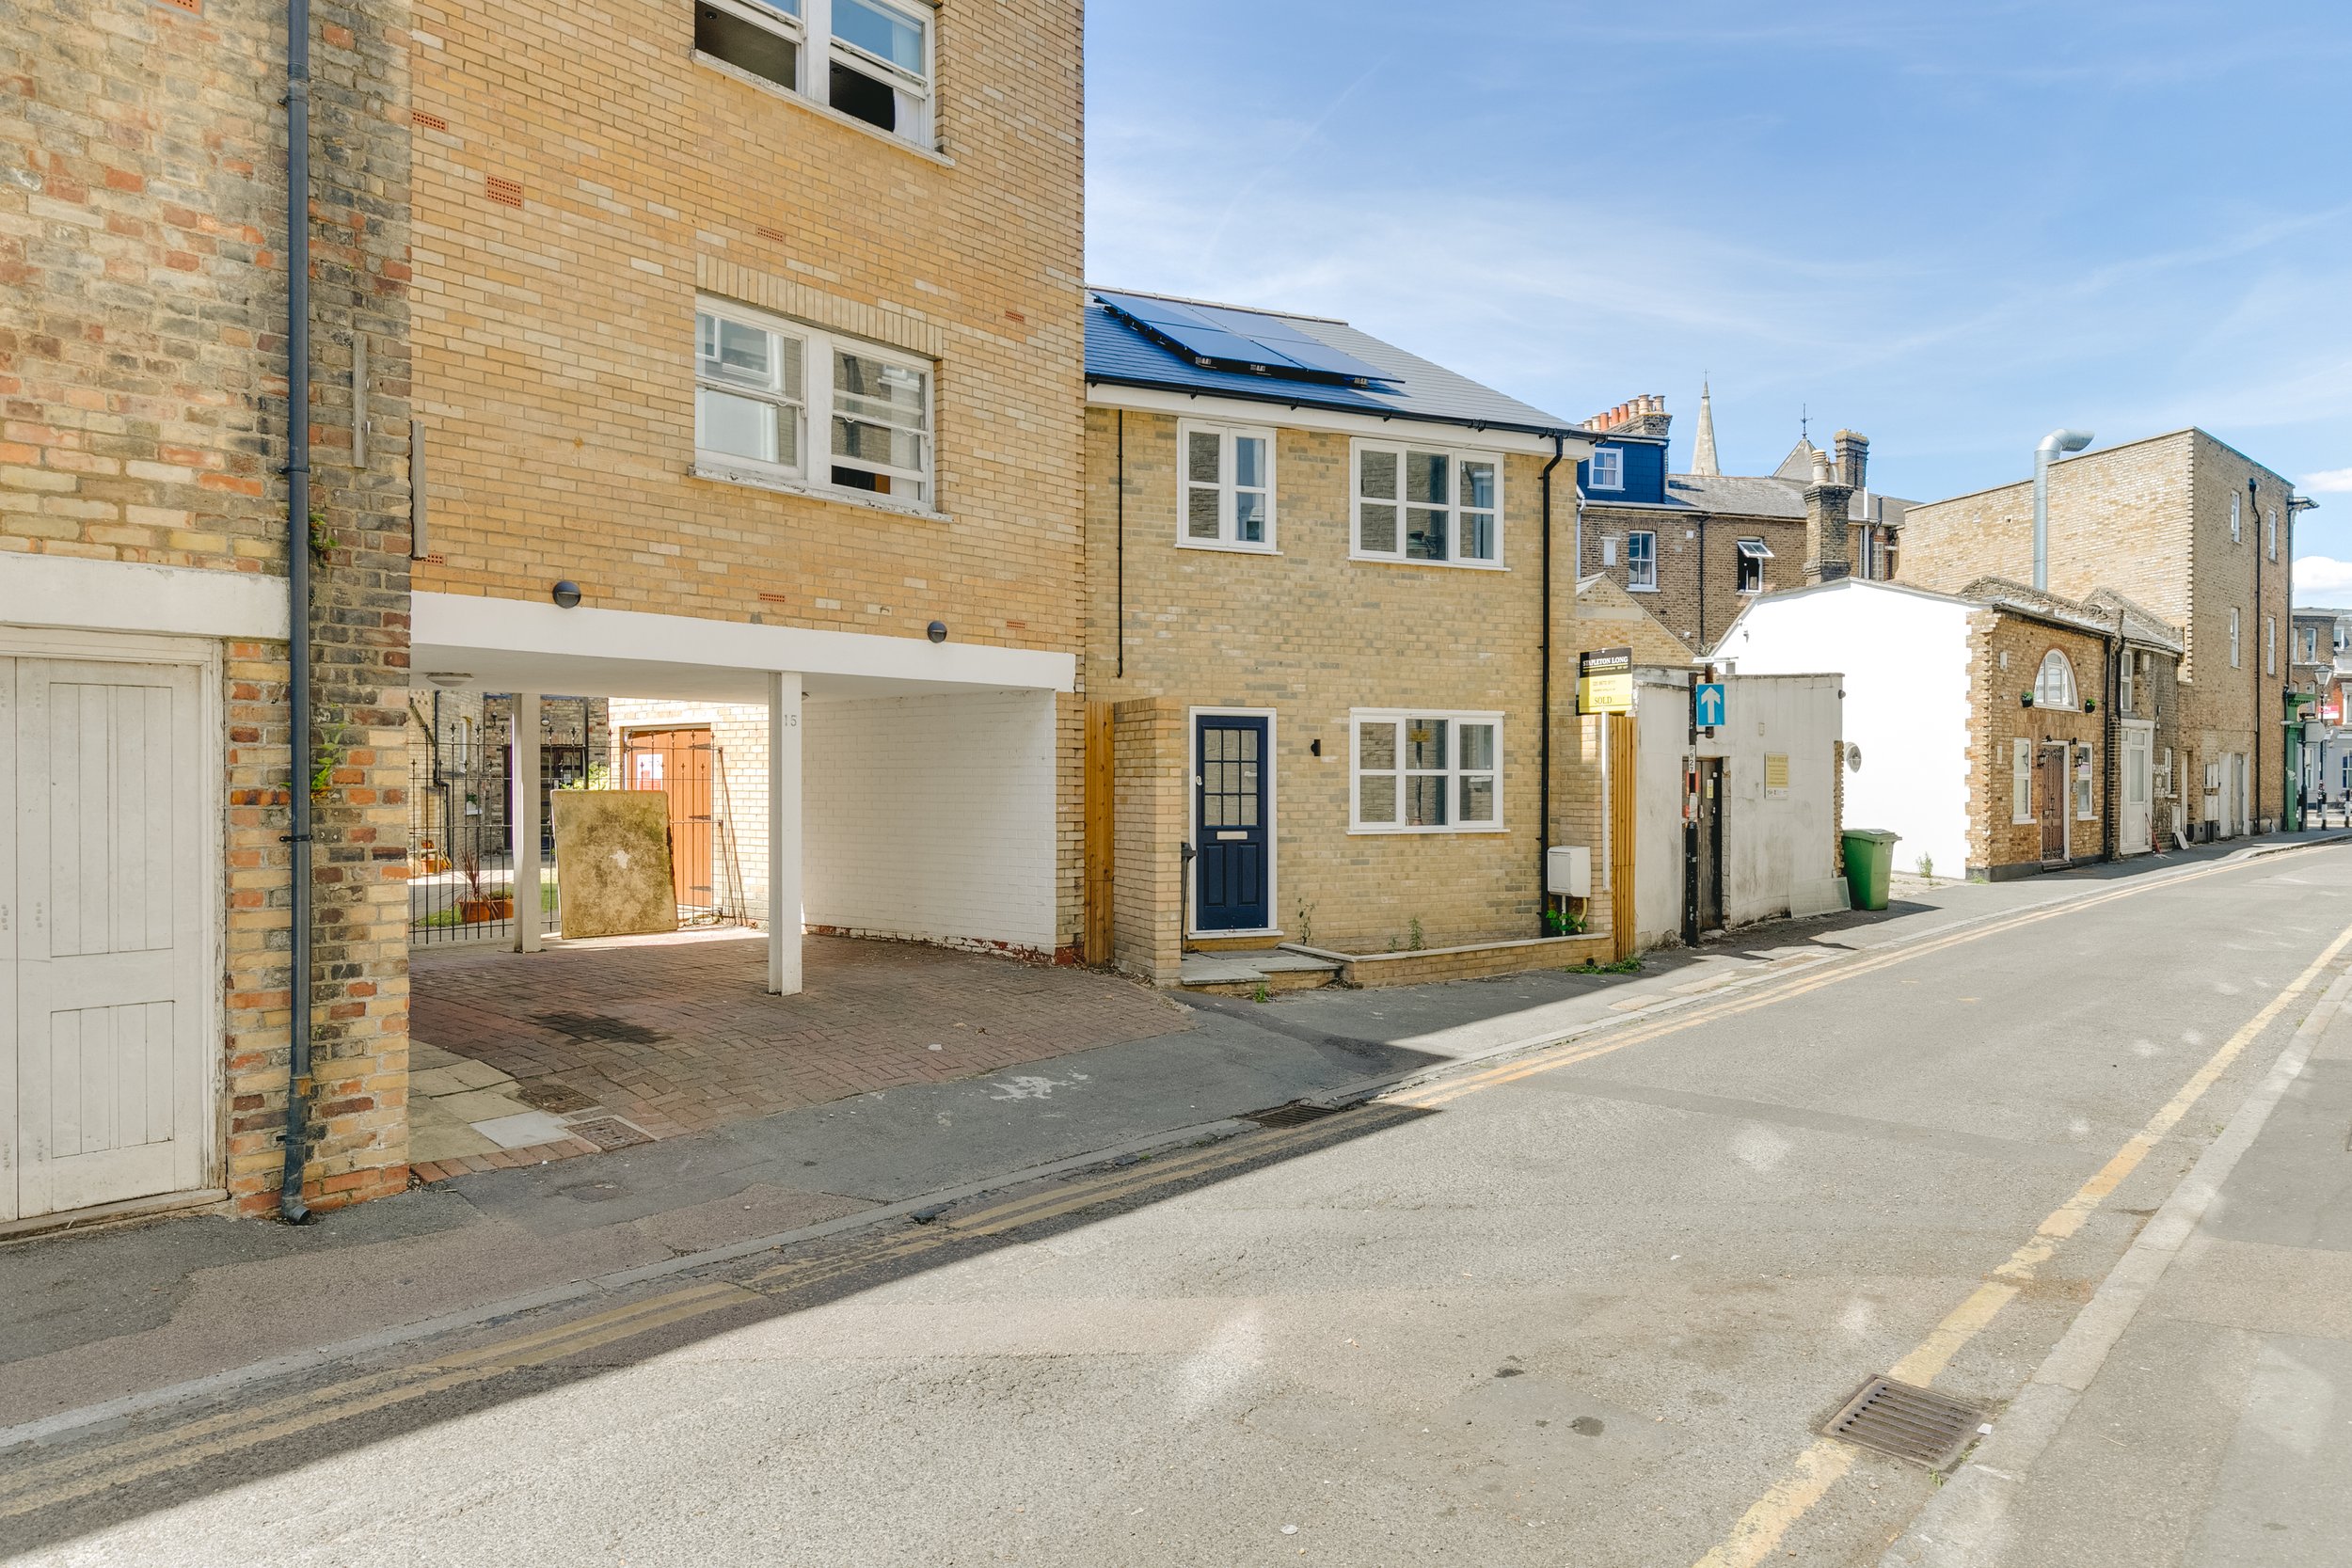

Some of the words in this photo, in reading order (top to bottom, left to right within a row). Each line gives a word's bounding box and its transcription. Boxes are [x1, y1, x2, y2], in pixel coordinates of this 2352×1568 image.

[1582, 657, 1611, 666] STAPLETON
[1594, 696, 1613, 705] SOLD
[784, 714, 797, 727] 15
